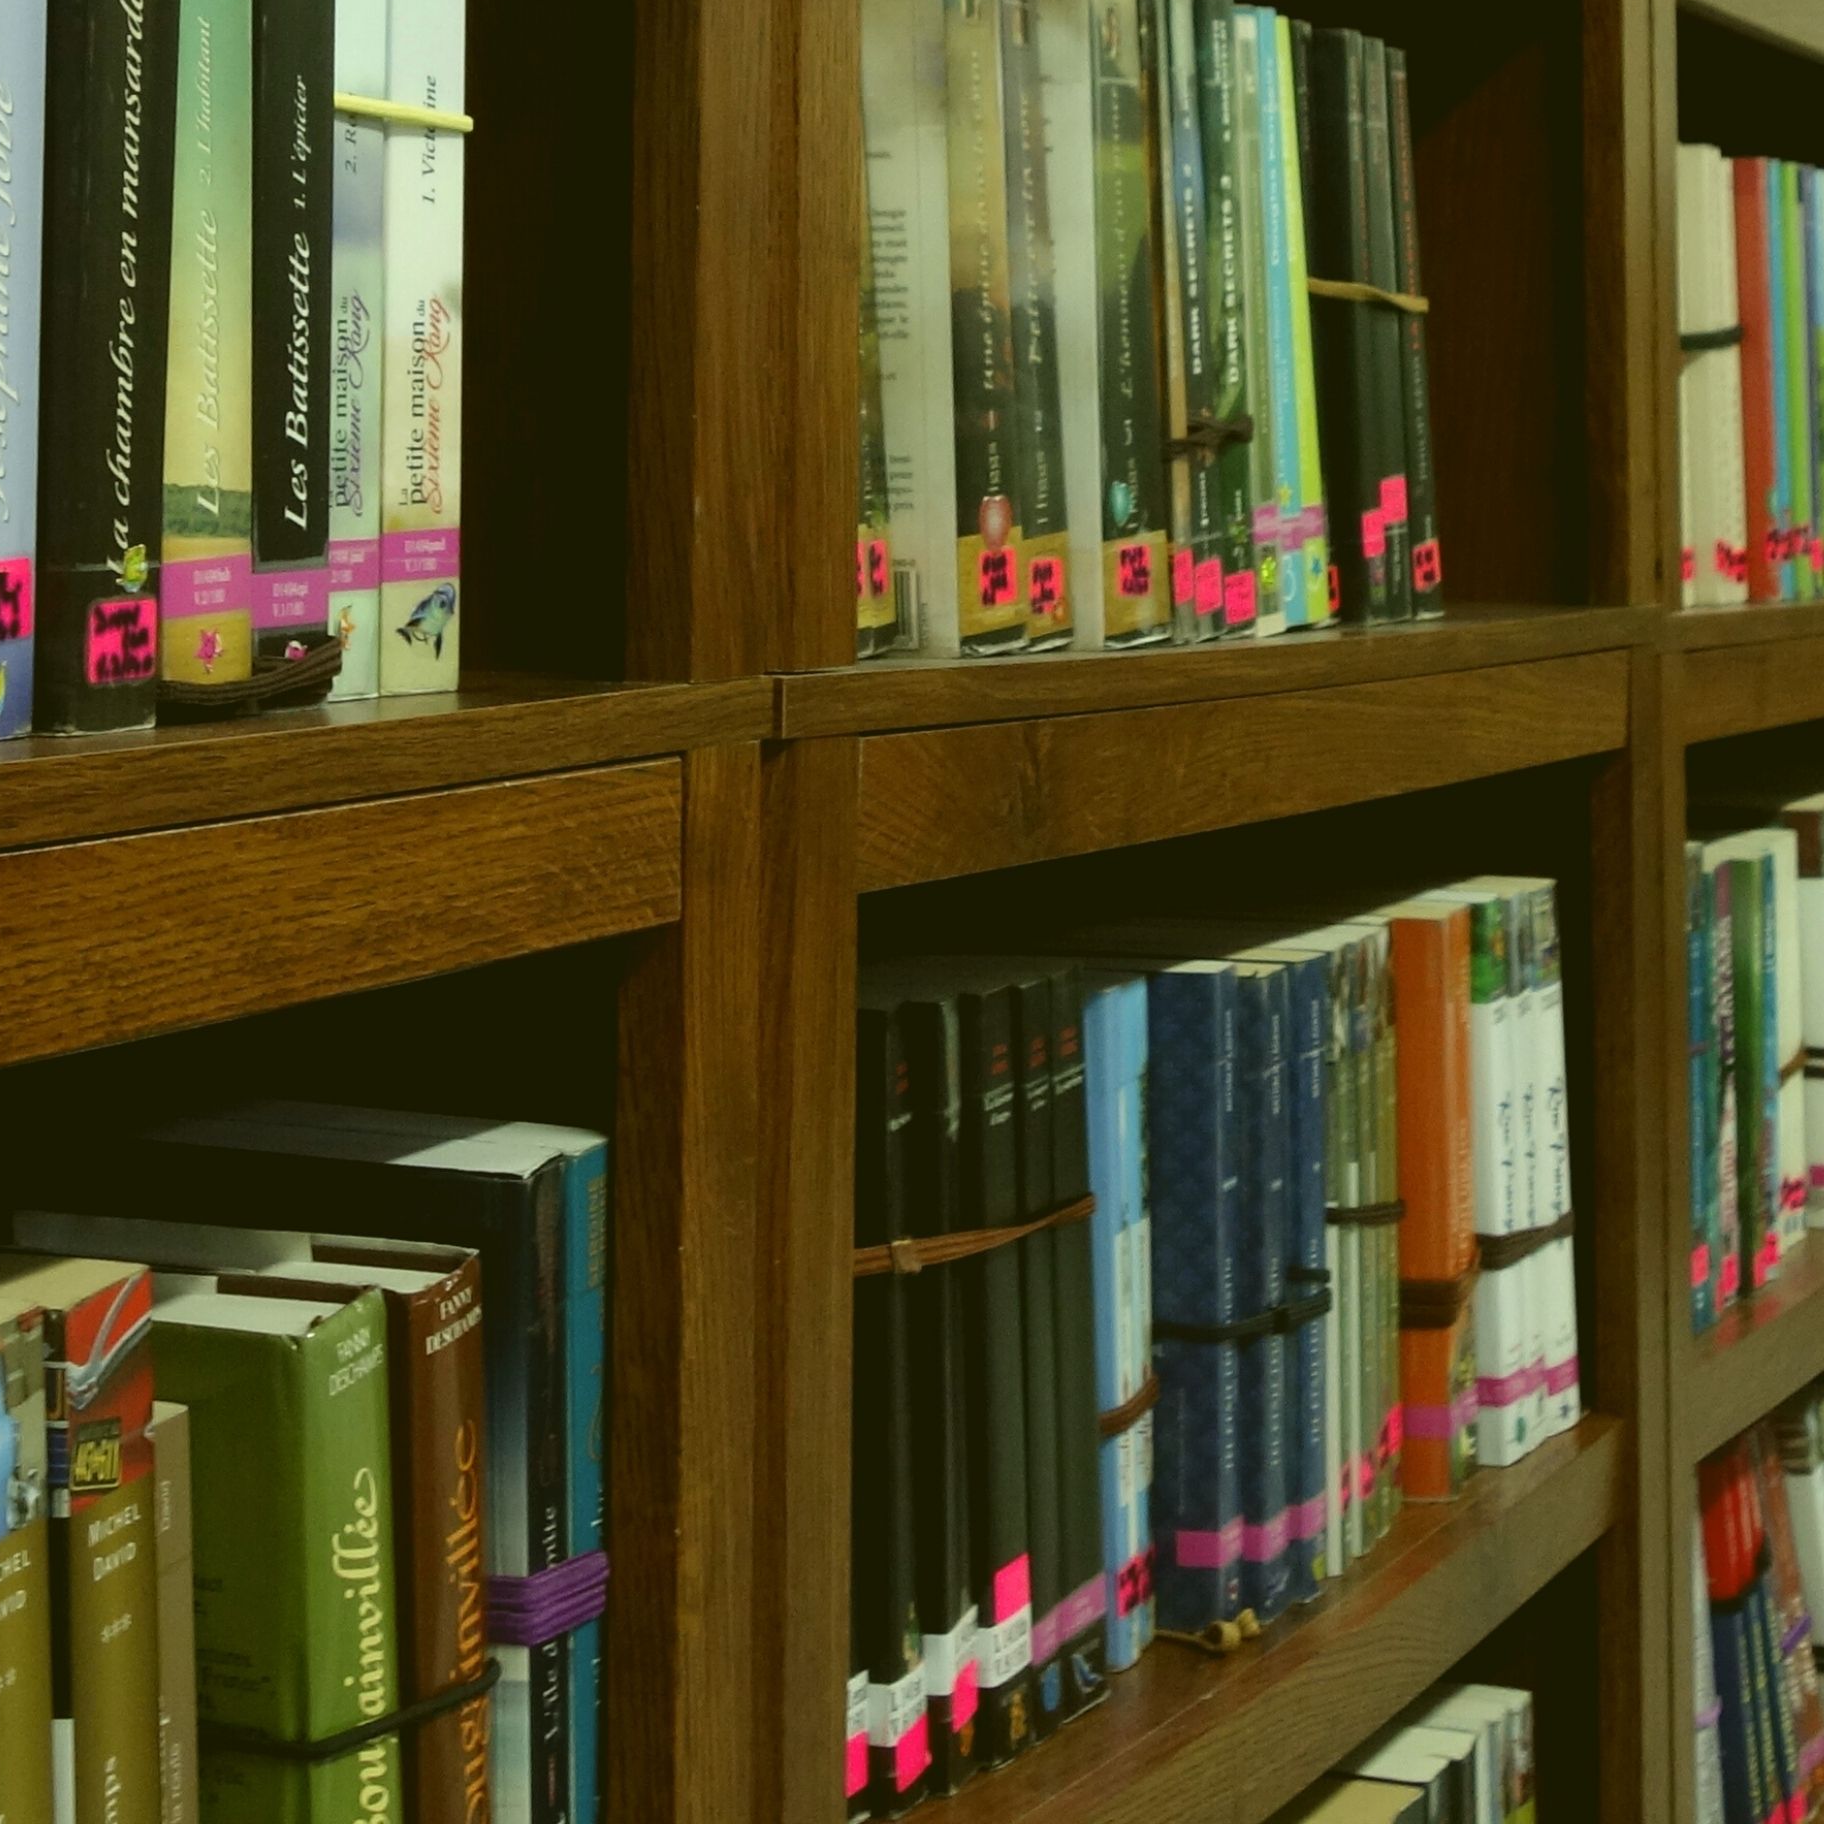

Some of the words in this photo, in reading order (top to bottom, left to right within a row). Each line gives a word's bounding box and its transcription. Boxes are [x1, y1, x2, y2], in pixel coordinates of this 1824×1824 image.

[422, 188, 435, 204] 1.
[121, 234, 139, 290] en
[1222, 200, 1236, 309] SECRETS
[197, 208, 219, 433] Batissette
[284, 231, 313, 449] Batissette
[1189, 307, 1203, 375] DARK
[1226, 318, 1239, 383] DARK
[333, 319, 349, 417] maison
[407, 322, 428, 417] maison
[109, 303, 138, 508] chambre
[197, 448, 223, 518] Les
[283, 456, 311, 533] Les
[332, 429, 348, 508] petite
[407, 429, 427, 505] petite
[438, 1286, 474, 1322] FANNY
[335, 1324, 372, 1362] FANNY
[88, 1503, 142, 1547] MICHEL
[93, 1542, 137, 1582] DAVID
